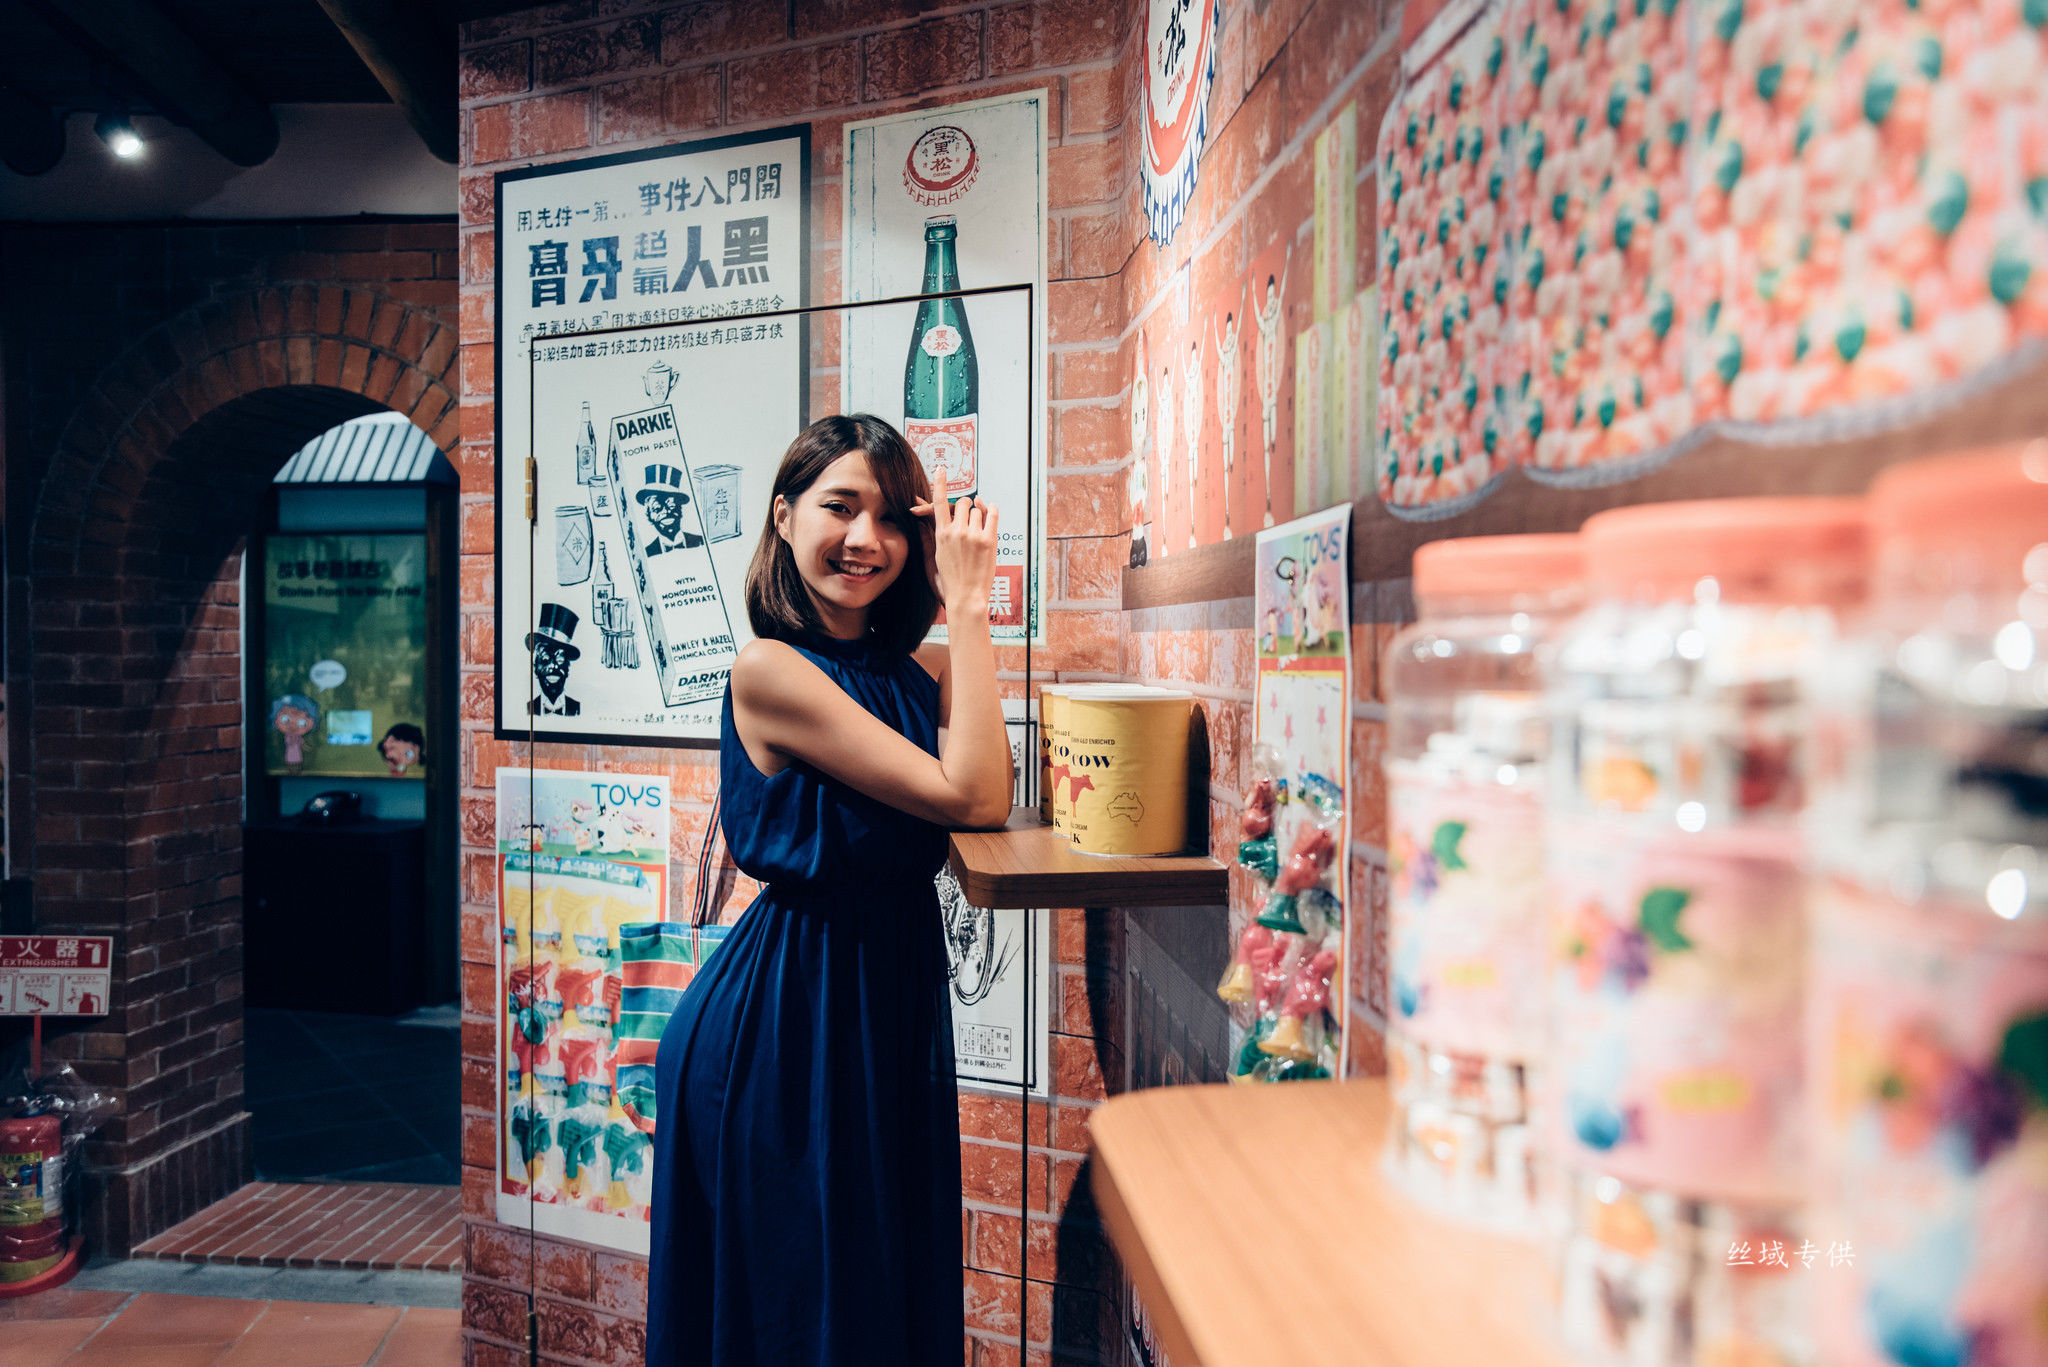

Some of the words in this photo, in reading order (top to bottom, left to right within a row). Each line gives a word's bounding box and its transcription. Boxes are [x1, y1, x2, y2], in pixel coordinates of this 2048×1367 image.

[616, 411, 673, 441] DARKIE
[623, 444, 650, 457] TOOTH
[653, 438, 679, 450] PASTE
[1302, 526, 1341, 566] TOYS
[675, 576, 696, 586] WITH
[662, 585, 714, 600] MONOFLUORO
[664, 594, 717, 609] PHOSPHATE
[670, 637, 699, 653] HAWLEY
[702, 637, 708, 646] &
[709, 634, 732, 646] HAZEL
[673, 650, 706, 663] CHEMICAL
[689, 681, 719, 691] SUPER
[1089, 738, 1116, 746] ENRICHED
[591, 783, 662, 807] TOYS
[3, 959, 78, 967] EXTINGUISHER
